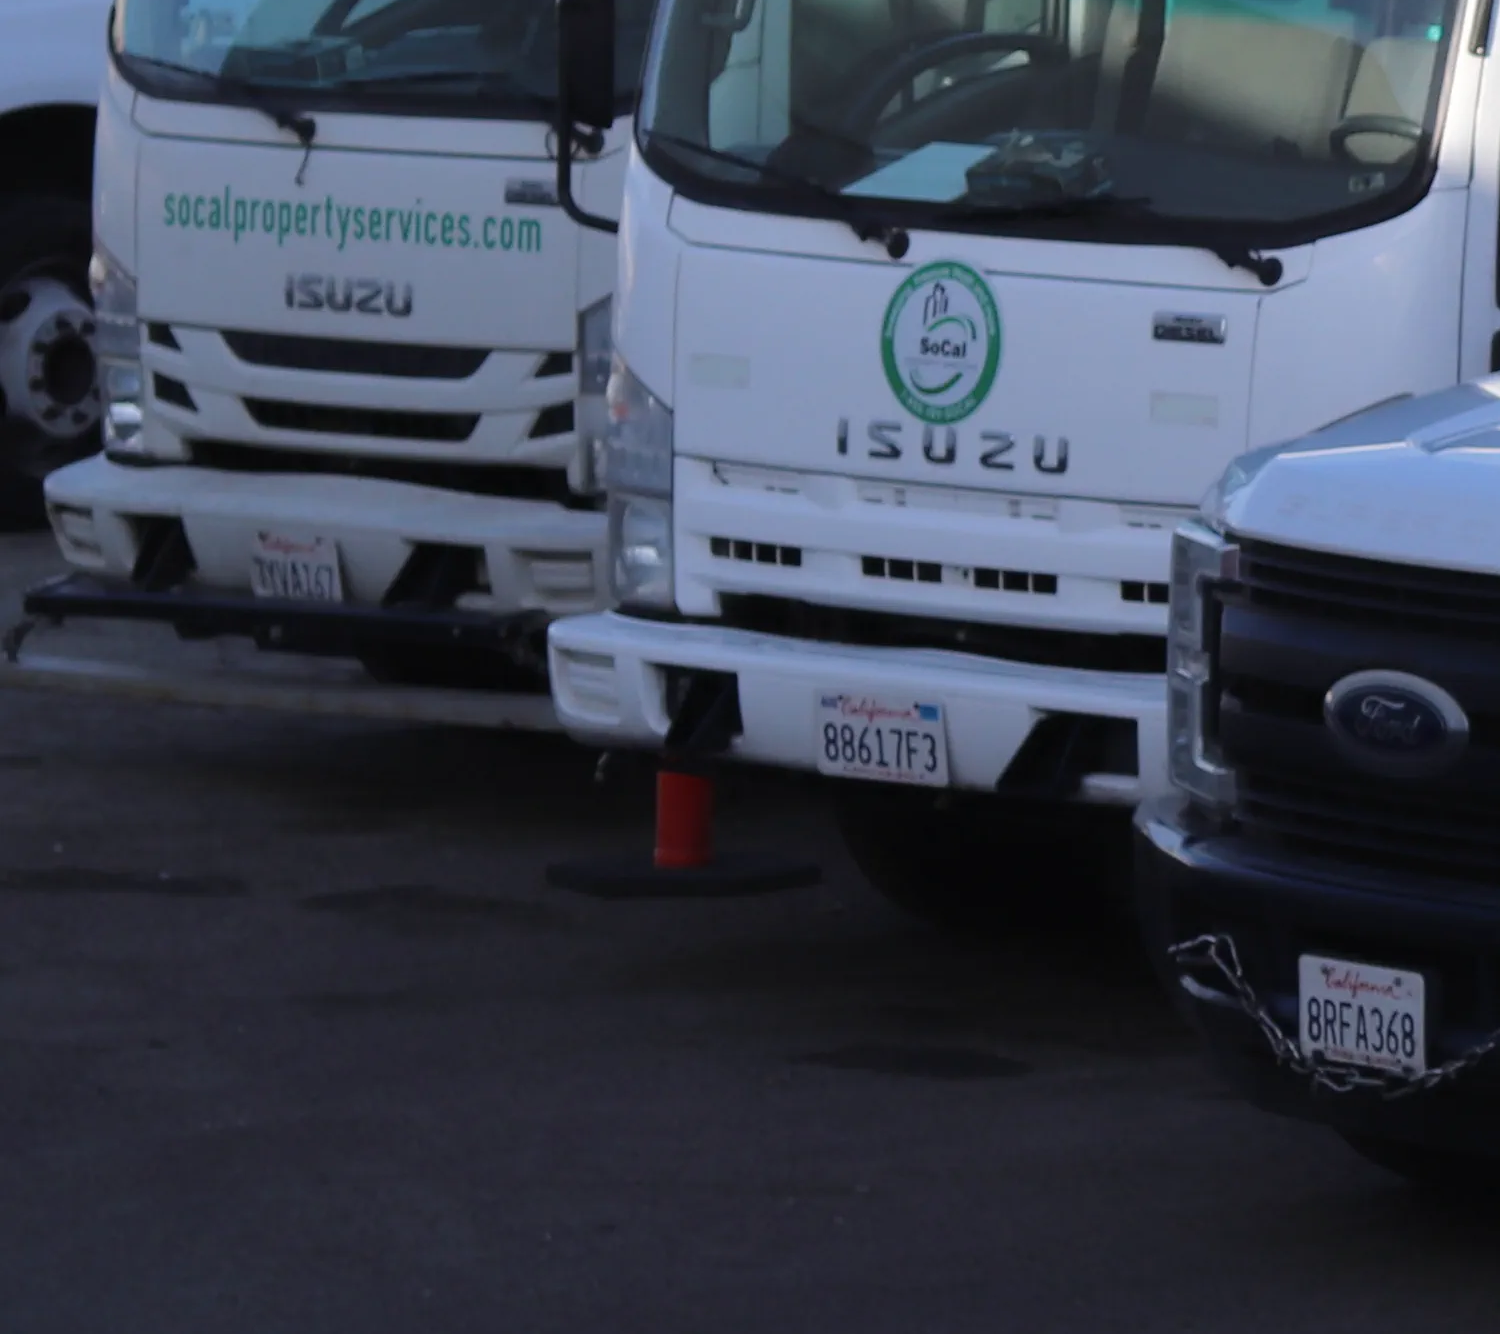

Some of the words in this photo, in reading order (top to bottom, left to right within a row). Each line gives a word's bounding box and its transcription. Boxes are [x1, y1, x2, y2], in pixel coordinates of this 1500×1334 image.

[163, 185, 542, 253] socalpropertyservices.com
[285, 273, 415, 317] ISUZU
[919, 336, 967, 358] SoCal
[837, 418, 1070, 475] ISUZU
[823, 721, 938, 773] 88617F3
[1324, 965, 1400, 999] California
[1307, 996, 1416, 1058] 8RFA368
